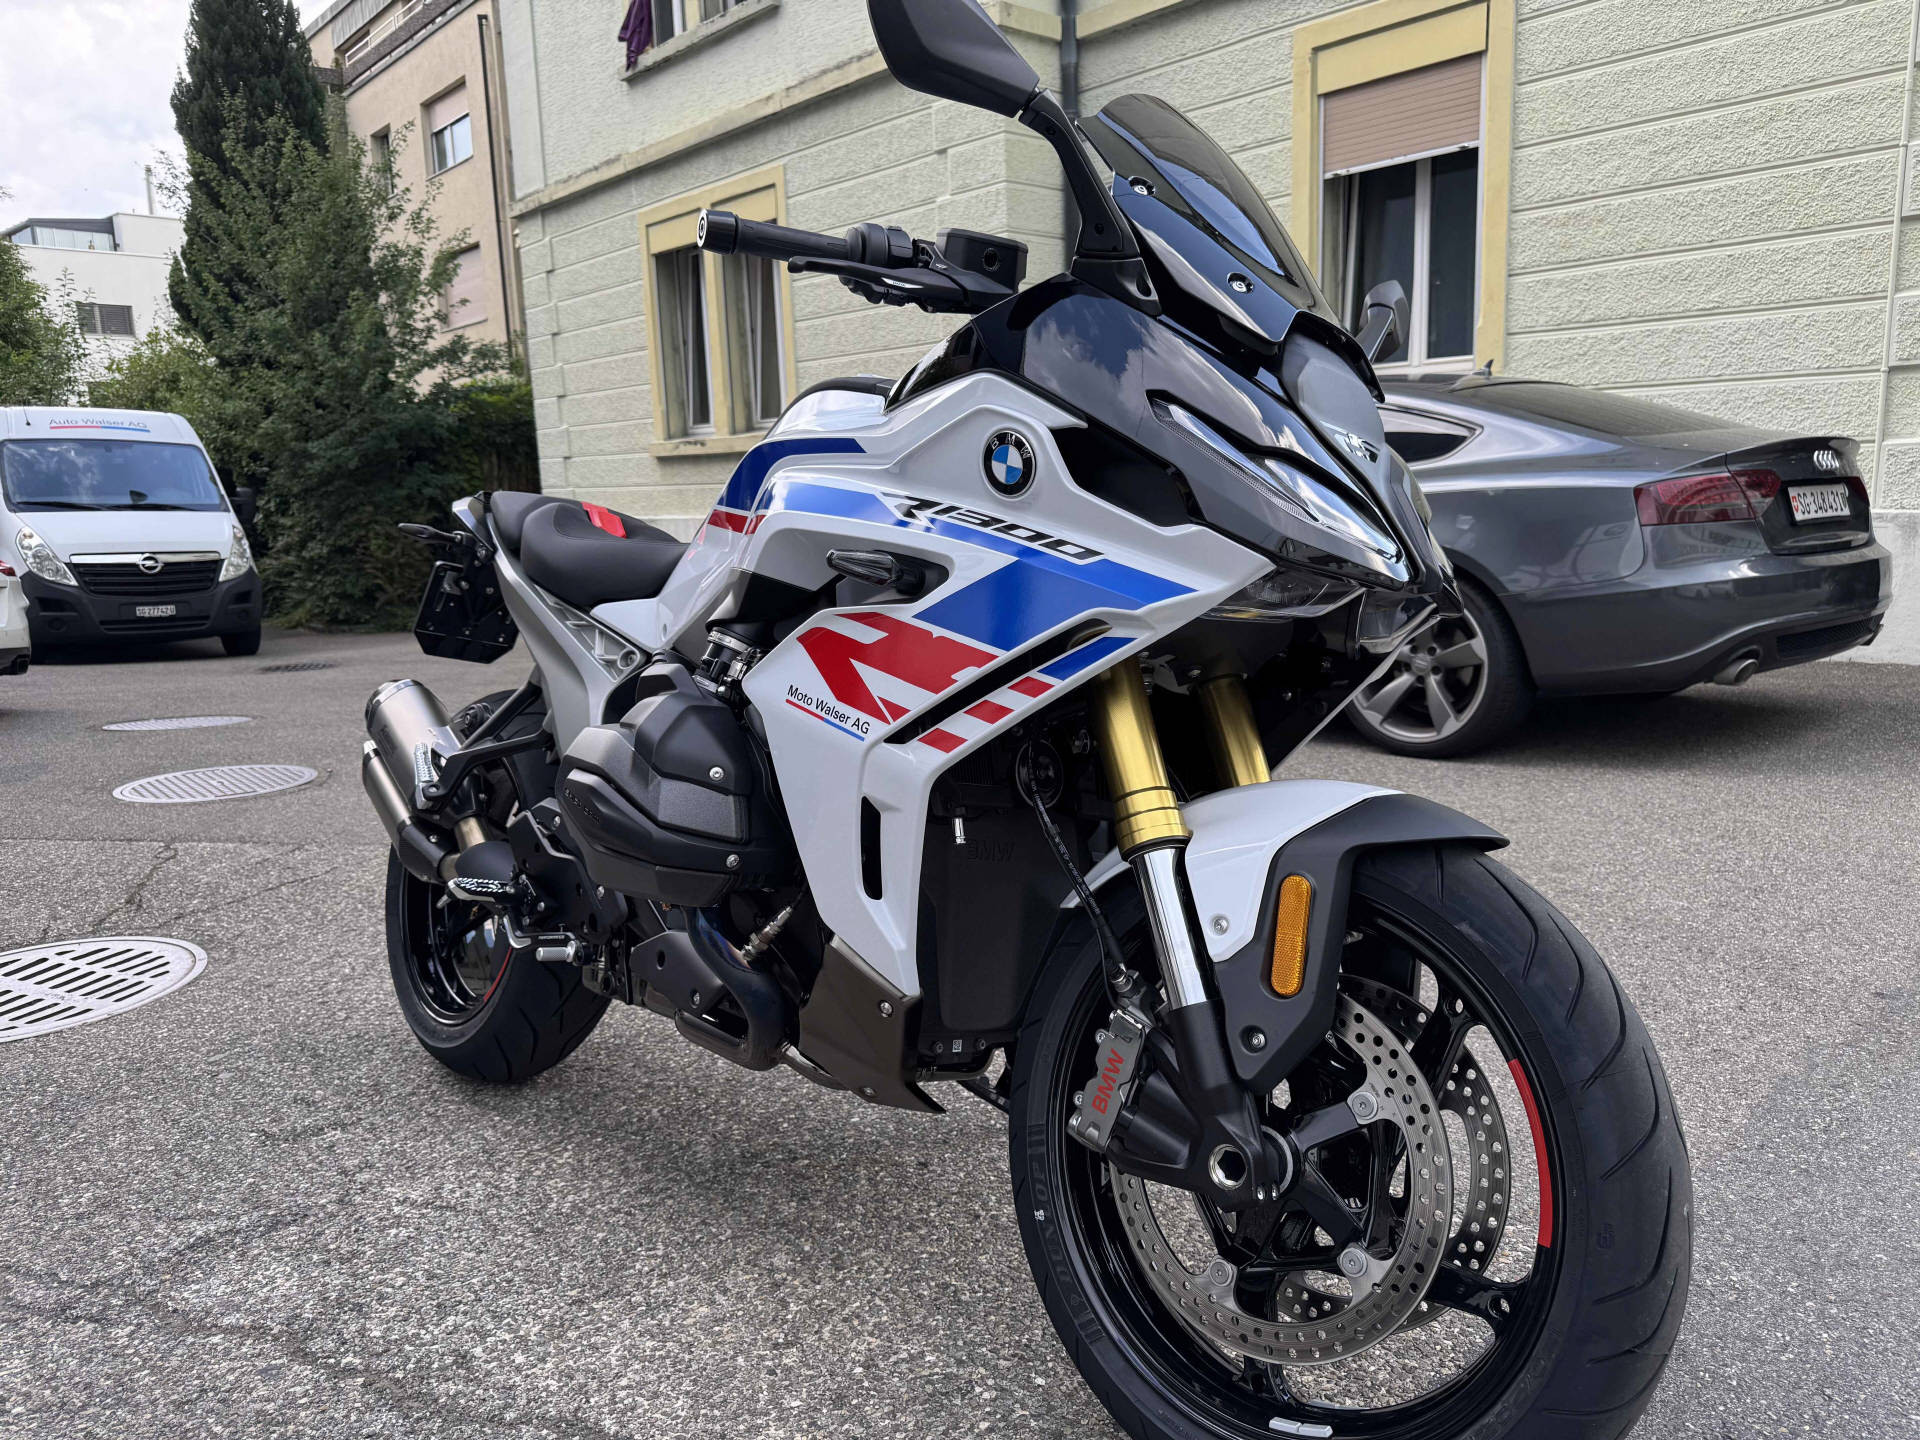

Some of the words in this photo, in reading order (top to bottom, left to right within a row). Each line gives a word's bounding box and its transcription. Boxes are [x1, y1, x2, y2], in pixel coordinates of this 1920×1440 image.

[49, 417, 79, 425] Auto
[81, 418, 124, 426] Walser
[128, 420, 148, 429] AG
[991, 433, 1031, 459] BMW
[787, 684, 813, 706] Moto
[815, 697, 851, 725] Walser
[851, 717, 870, 735] AG
[1091, 1047, 1125, 1115] BMW
